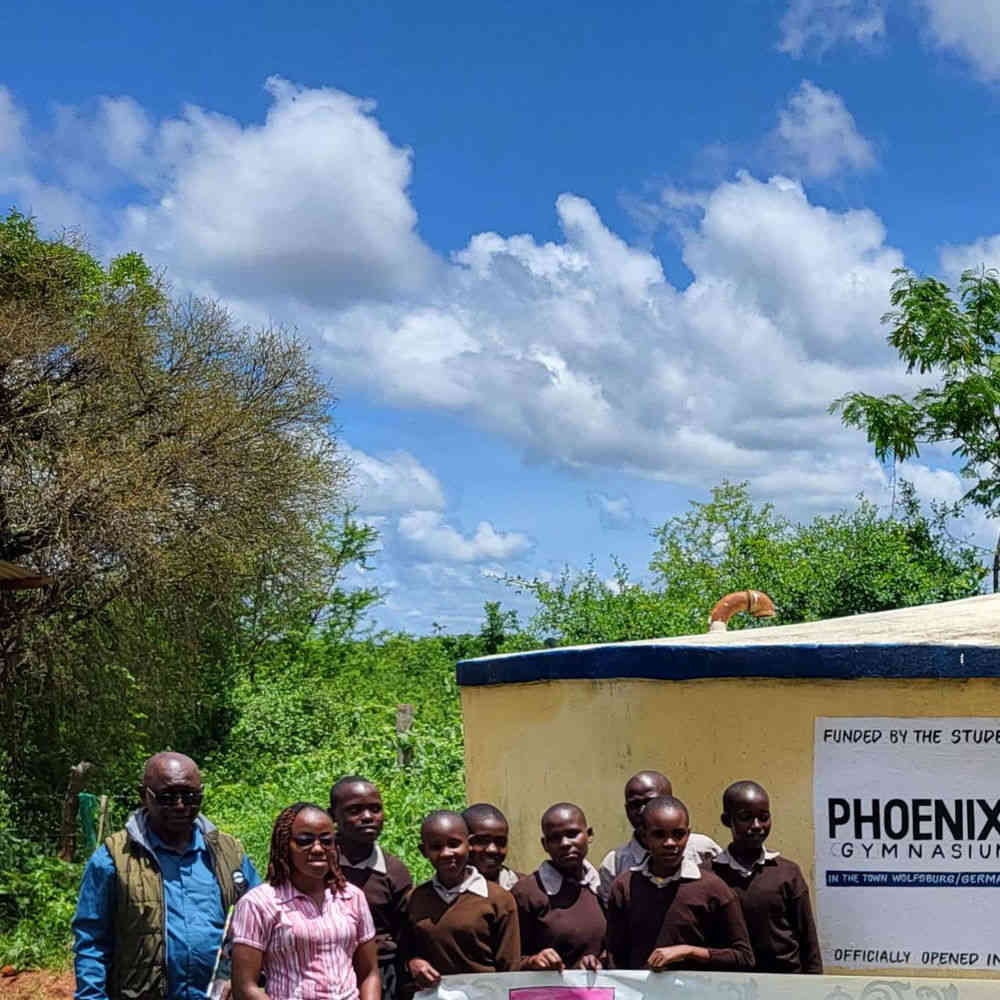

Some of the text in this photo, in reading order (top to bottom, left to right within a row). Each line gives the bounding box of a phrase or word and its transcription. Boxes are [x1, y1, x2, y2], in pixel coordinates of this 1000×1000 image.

[824, 729, 882, 744] FUNDED
[889, 729, 908, 743] BY
[913, 729, 942, 744] THE
[828, 874, 839, 884] IN
[842, 873, 859, 884] THE
[863, 873, 888, 884] TOWN
[834, 949, 911, 963] OFFICIALLY
[921, 952, 979, 965] OPENED
